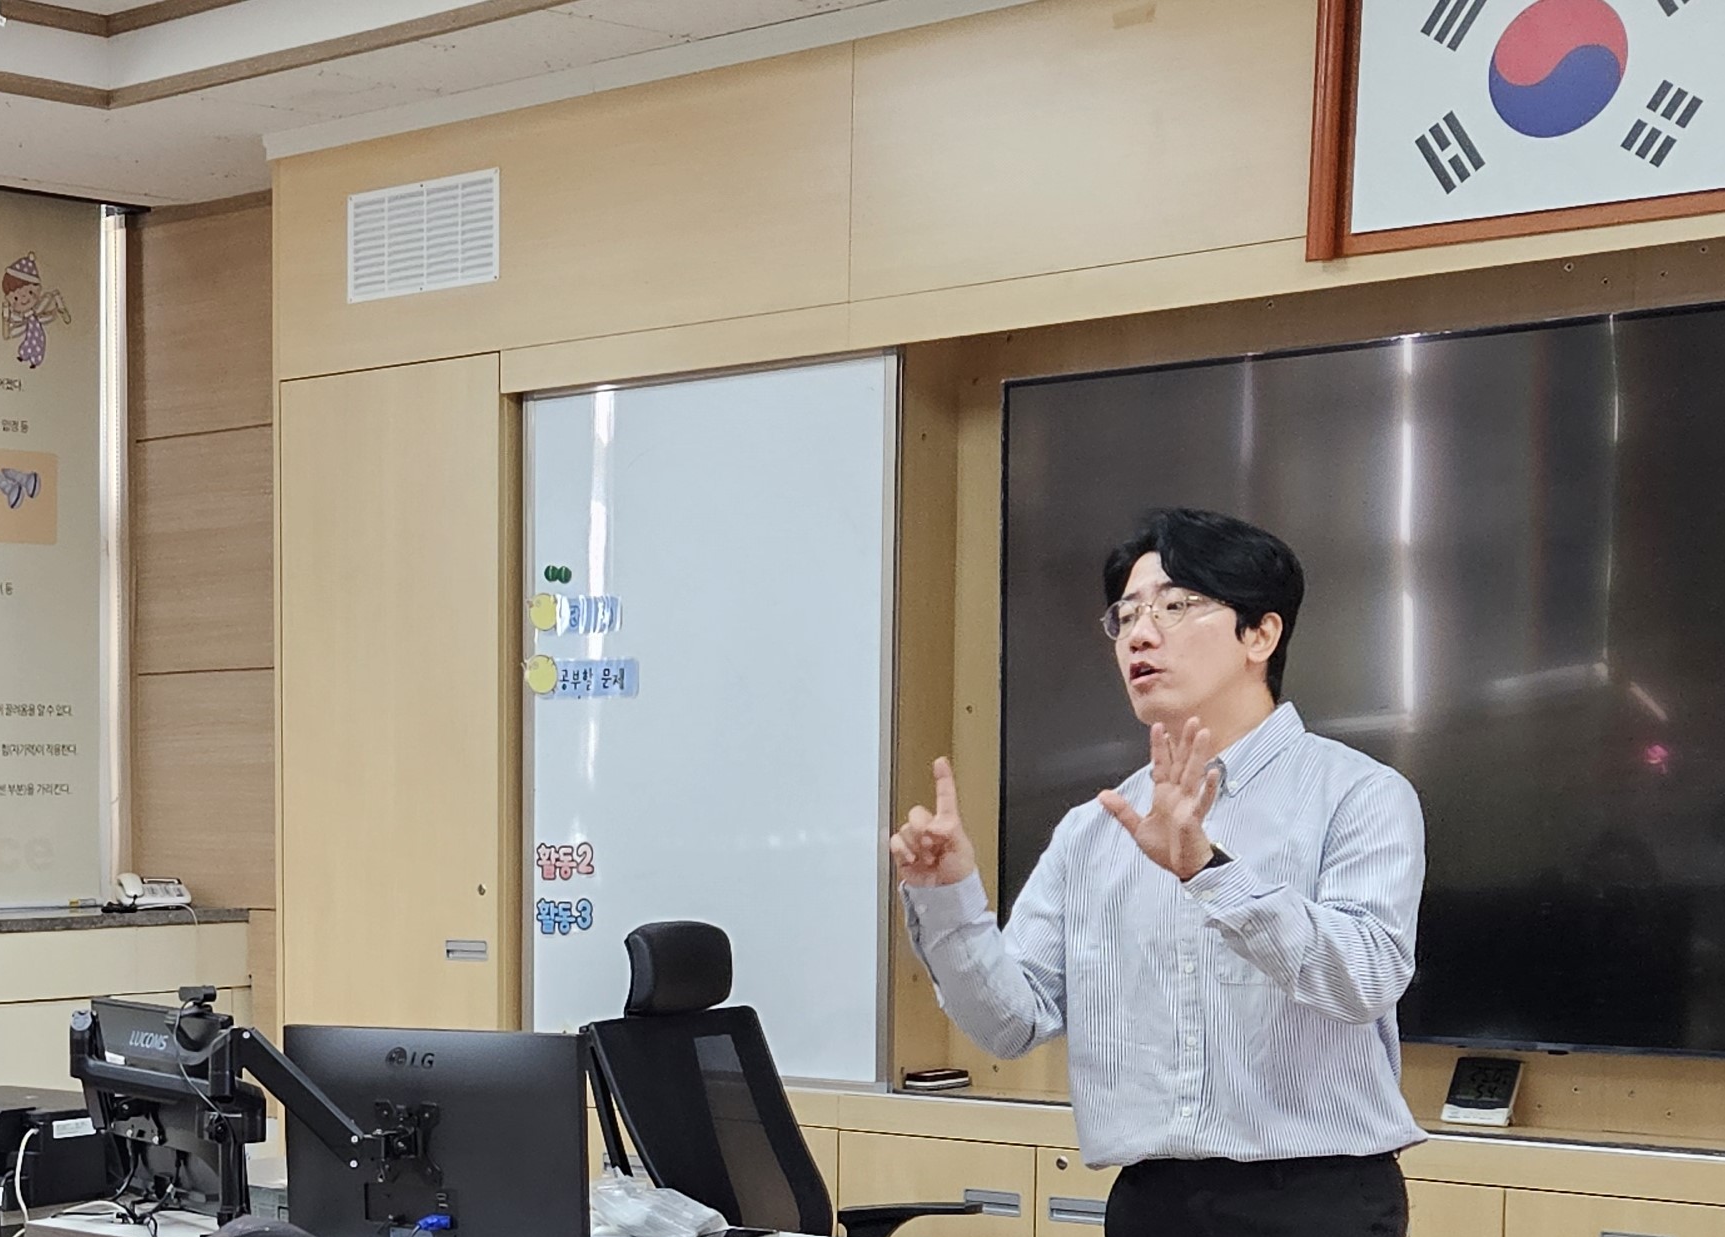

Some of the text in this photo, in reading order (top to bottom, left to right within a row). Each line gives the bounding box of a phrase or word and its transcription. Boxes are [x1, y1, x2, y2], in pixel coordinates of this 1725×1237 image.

[560, 667, 625, 691] 공부할 문제
[129, 1030, 170, 1051] LUCOMS
[410, 1051, 435, 1069] LG
